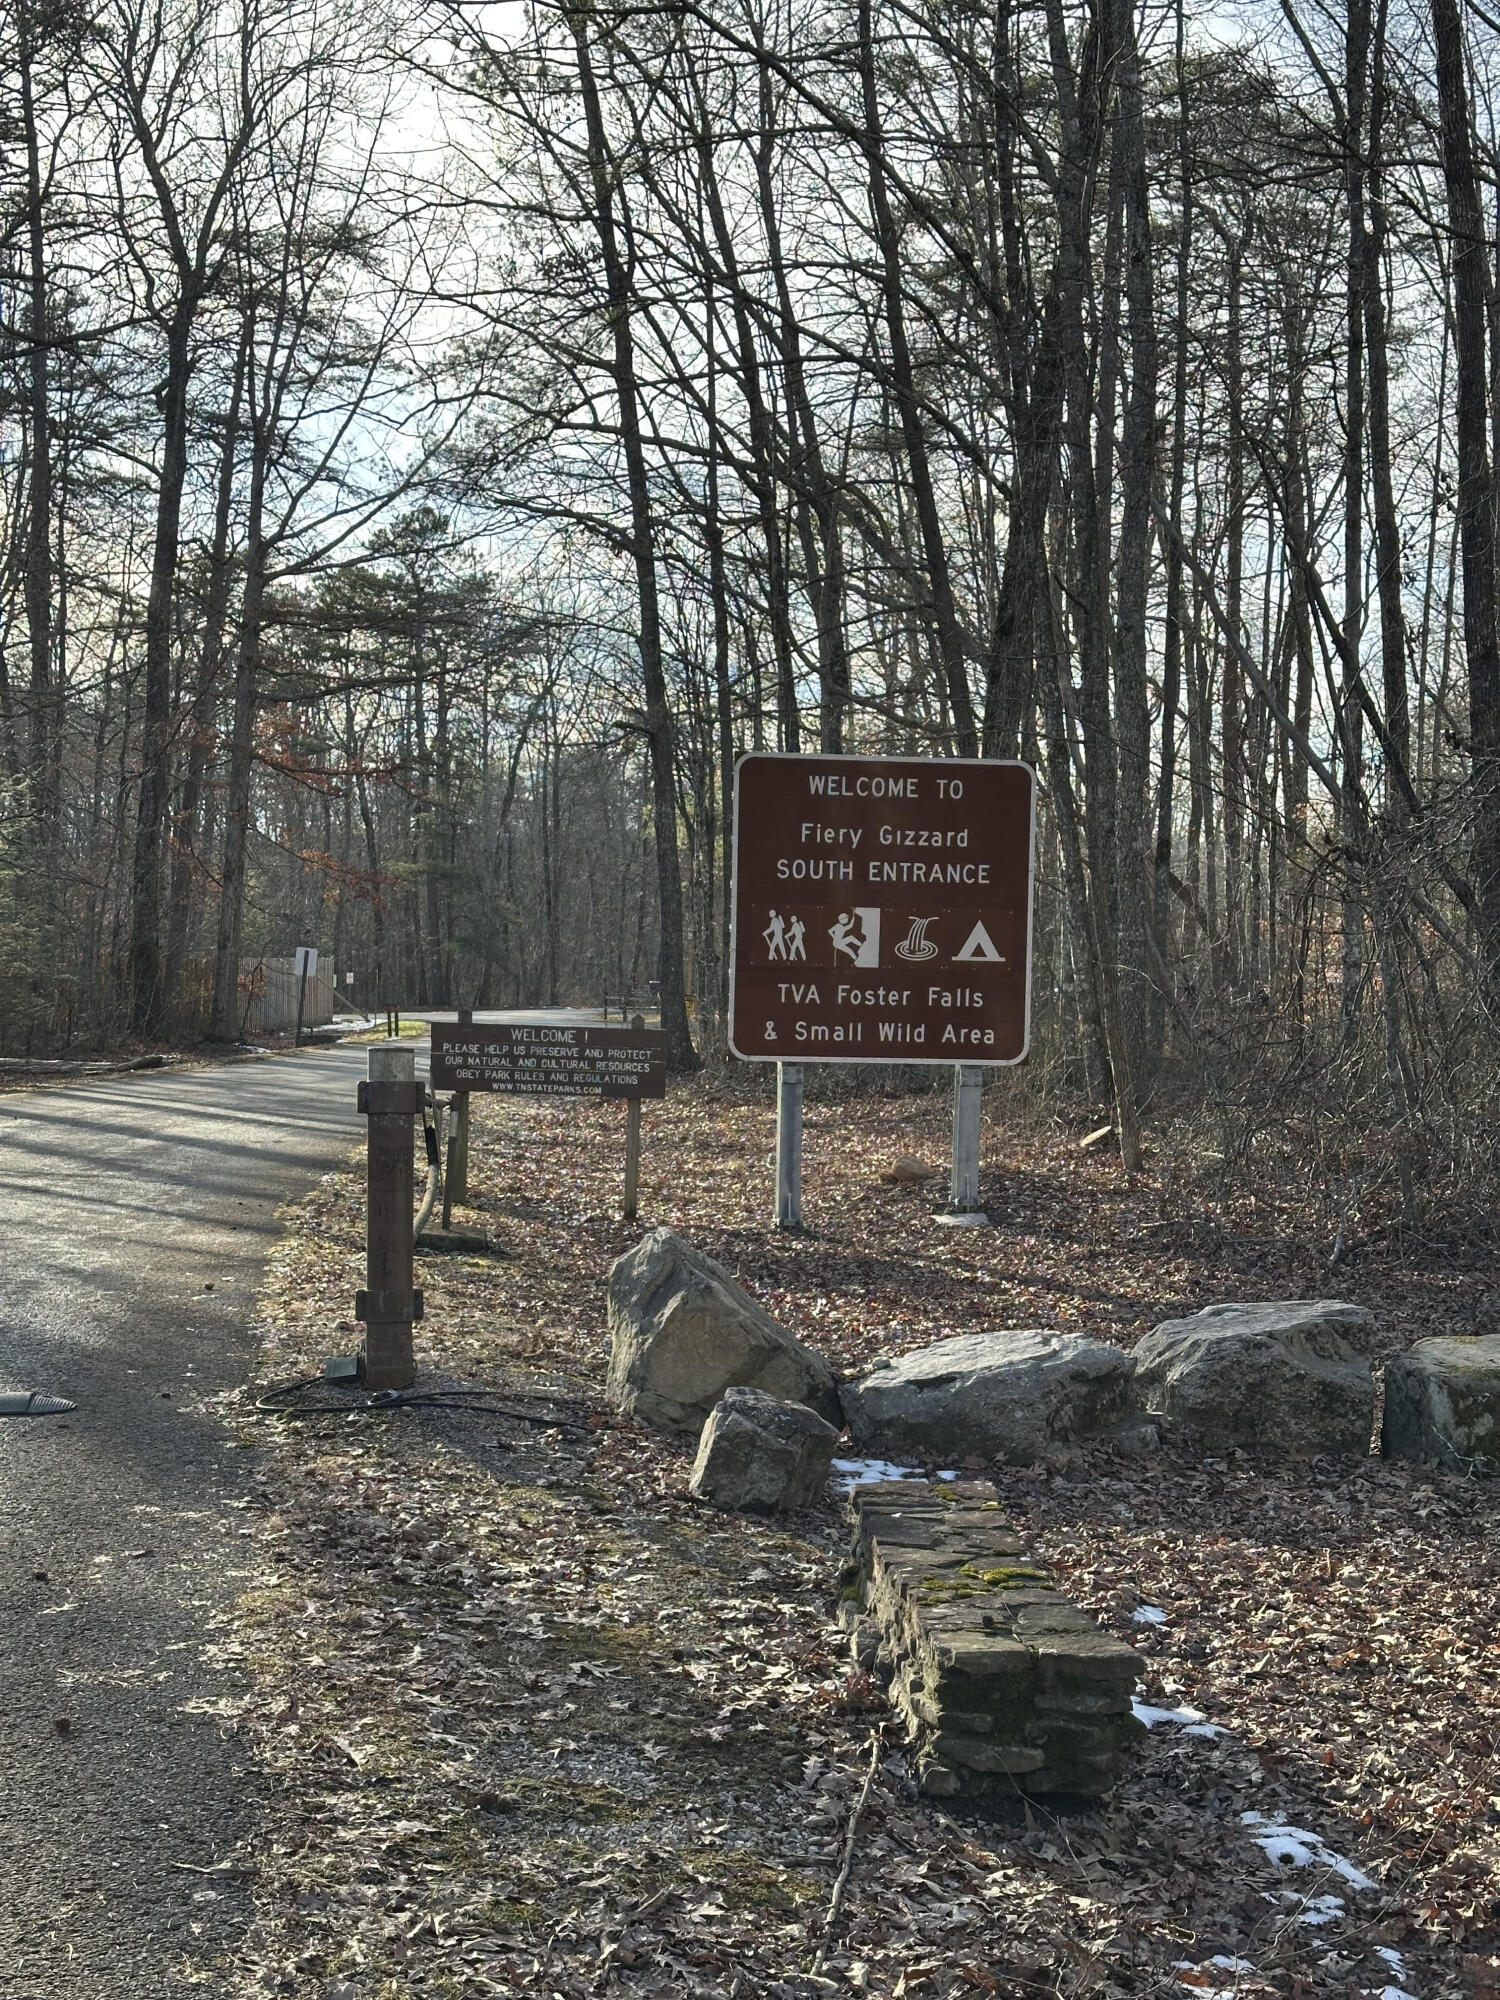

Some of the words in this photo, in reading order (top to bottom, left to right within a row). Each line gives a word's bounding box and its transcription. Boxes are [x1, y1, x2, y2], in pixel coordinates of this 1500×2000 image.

[809, 776, 918, 798] WELCOME
[937, 780, 963, 799] TO
[801, 823, 862, 848] Fiery
[880, 826, 968, 848] Gizzard
[777, 860, 853, 880] SOUTH
[869, 862, 990, 884] ENTRANCE
[778, 984, 820, 1004] TVA
[838, 985, 910, 1006] Foster
[929, 987, 983, 1007] Falls
[511, 1028, 576, 1043] WELCOME
[764, 1022, 777, 1040] &
[795, 1022, 861, 1041] Small
[879, 1023, 925, 1043] Wild
[942, 1024, 994, 1044] Area
[443, 1043, 479, 1054] PLEASE
[485, 1045, 509, 1054] HELP
[514, 1046, 525, 1055] US
[531, 1047, 579, 1057] PRESERVE
[585, 1048, 603, 1058] AND
[608, 1049, 652, 1059] PROTECT
[446, 1056, 463, 1065] OUR
[468, 1057, 512, 1067] NATURAL
[519, 1058, 536, 1068] AND
[541, 1059, 590, 1069] CULTURAL
[596, 1062, 650, 1072] RESOURCES
[457, 1069, 480, 1079] OBEY
[485, 1070, 509, 1080] PARK
[515, 1072, 544, 1081] RULES
[550, 1073, 568, 1082] AND
[574, 1073, 638, 1085] REGULATIONS
[493, 1083, 601, 1094] WWW.TNSTATEPARKS.COM
